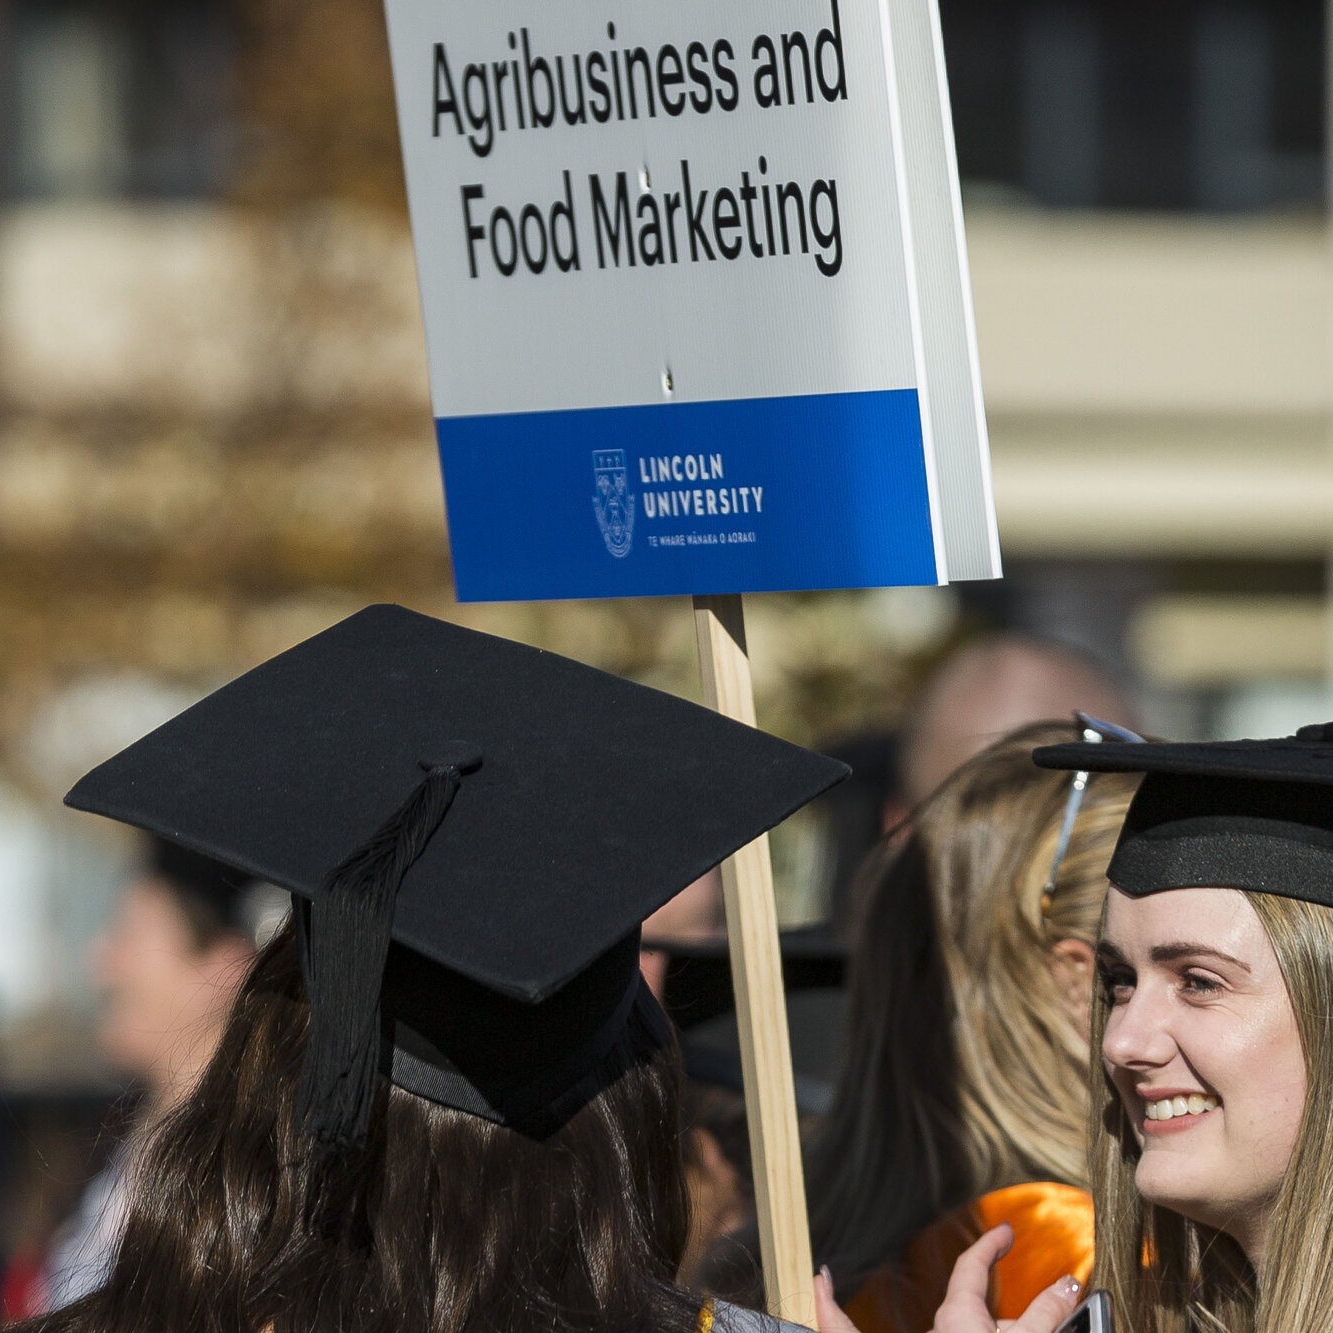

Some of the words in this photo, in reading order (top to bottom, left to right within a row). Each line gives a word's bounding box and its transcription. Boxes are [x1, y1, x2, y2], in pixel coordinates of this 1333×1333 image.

[432, 21, 739, 157] Agribusiness
[752, 0, 848, 108] and
[460, 169, 581, 279] Food
[588, 155, 844, 278] Marketing
[639, 453, 724, 483] LINCOLN
[643, 487, 764, 518] UNIVERSITY
[648, 535, 658, 547] TE
[659, 534, 686, 546] WHARE
